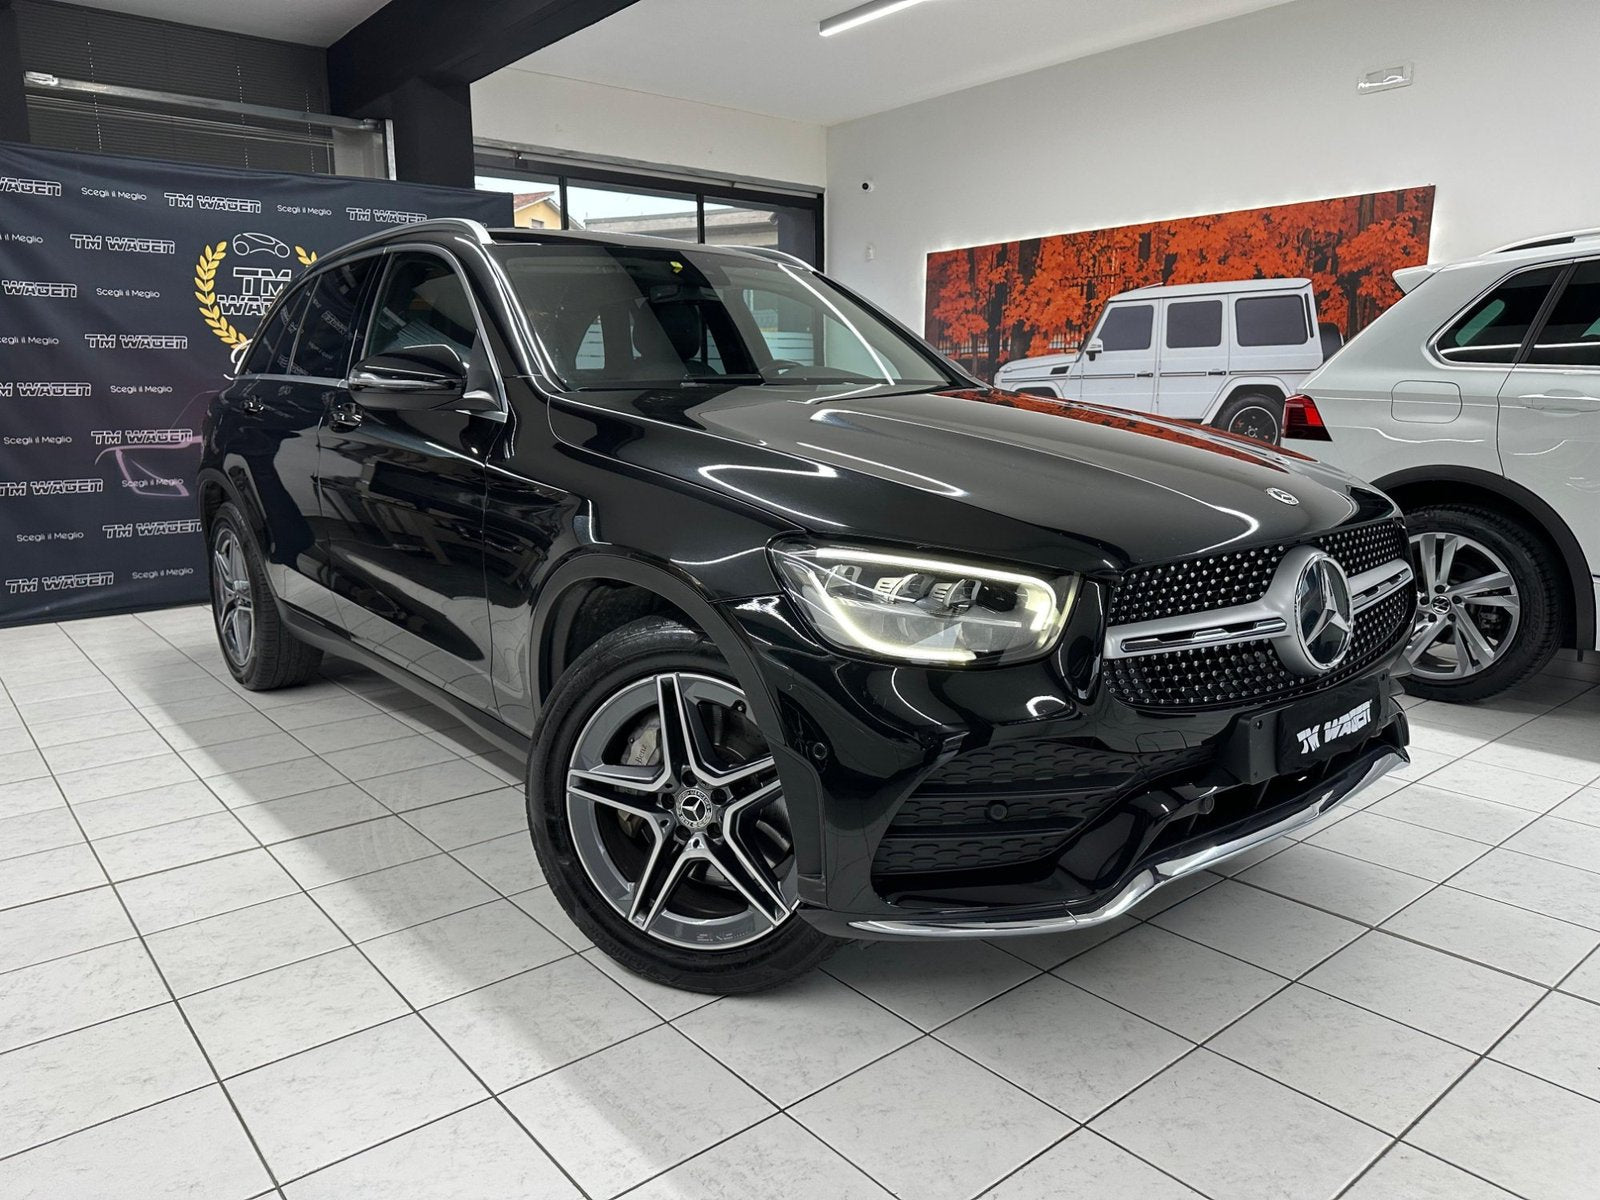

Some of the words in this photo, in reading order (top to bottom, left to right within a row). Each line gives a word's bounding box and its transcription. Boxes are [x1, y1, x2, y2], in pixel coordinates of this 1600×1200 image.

[81, 187, 109, 198] Scegli
[118, 191, 147, 201] Meglio
[164, 192, 193, 208] TM
[197, 195, 261, 214] WAGEN
[277, 204, 300, 215] Scegli
[308, 207, 332, 217] Meglio
[346, 207, 371, 221] TM
[12, 233, 44, 244] Meglio
[70, 234, 102, 250] TM
[105, 236, 175, 254] WAGEN
[233, 267, 291, 296] TM
[2, 280, 77, 298] WAGEN
[96, 287, 123, 298] Scegli
[132, 289, 160, 299] Meglio
[28, 336, 59, 346] Meglio
[85, 334, 116, 349] TM
[119, 335, 188, 350] WAGEN
[17, 382, 92, 397] WAGEN
[110, 385, 137, 395] Scegli
[144, 386, 173, 395] Meglio
[3, 437, 33, 445] Scegli
[42, 436, 73, 444] Meglio
[91, 430, 121, 445] TM
[125, 428, 193, 444] WAGEN
[30, 479, 104, 496] WAGEN
[102, 523, 133, 539] TM
[136, 518, 203, 536] WAGEN
[16, 534, 46, 543] Scegli
[53, 532, 84, 541] Meglio
[132, 570, 159, 580] Scegli
[166, 567, 194, 576] Meglio
[5, 577, 39, 594] TM
[41, 571, 115, 591] WAGEN
